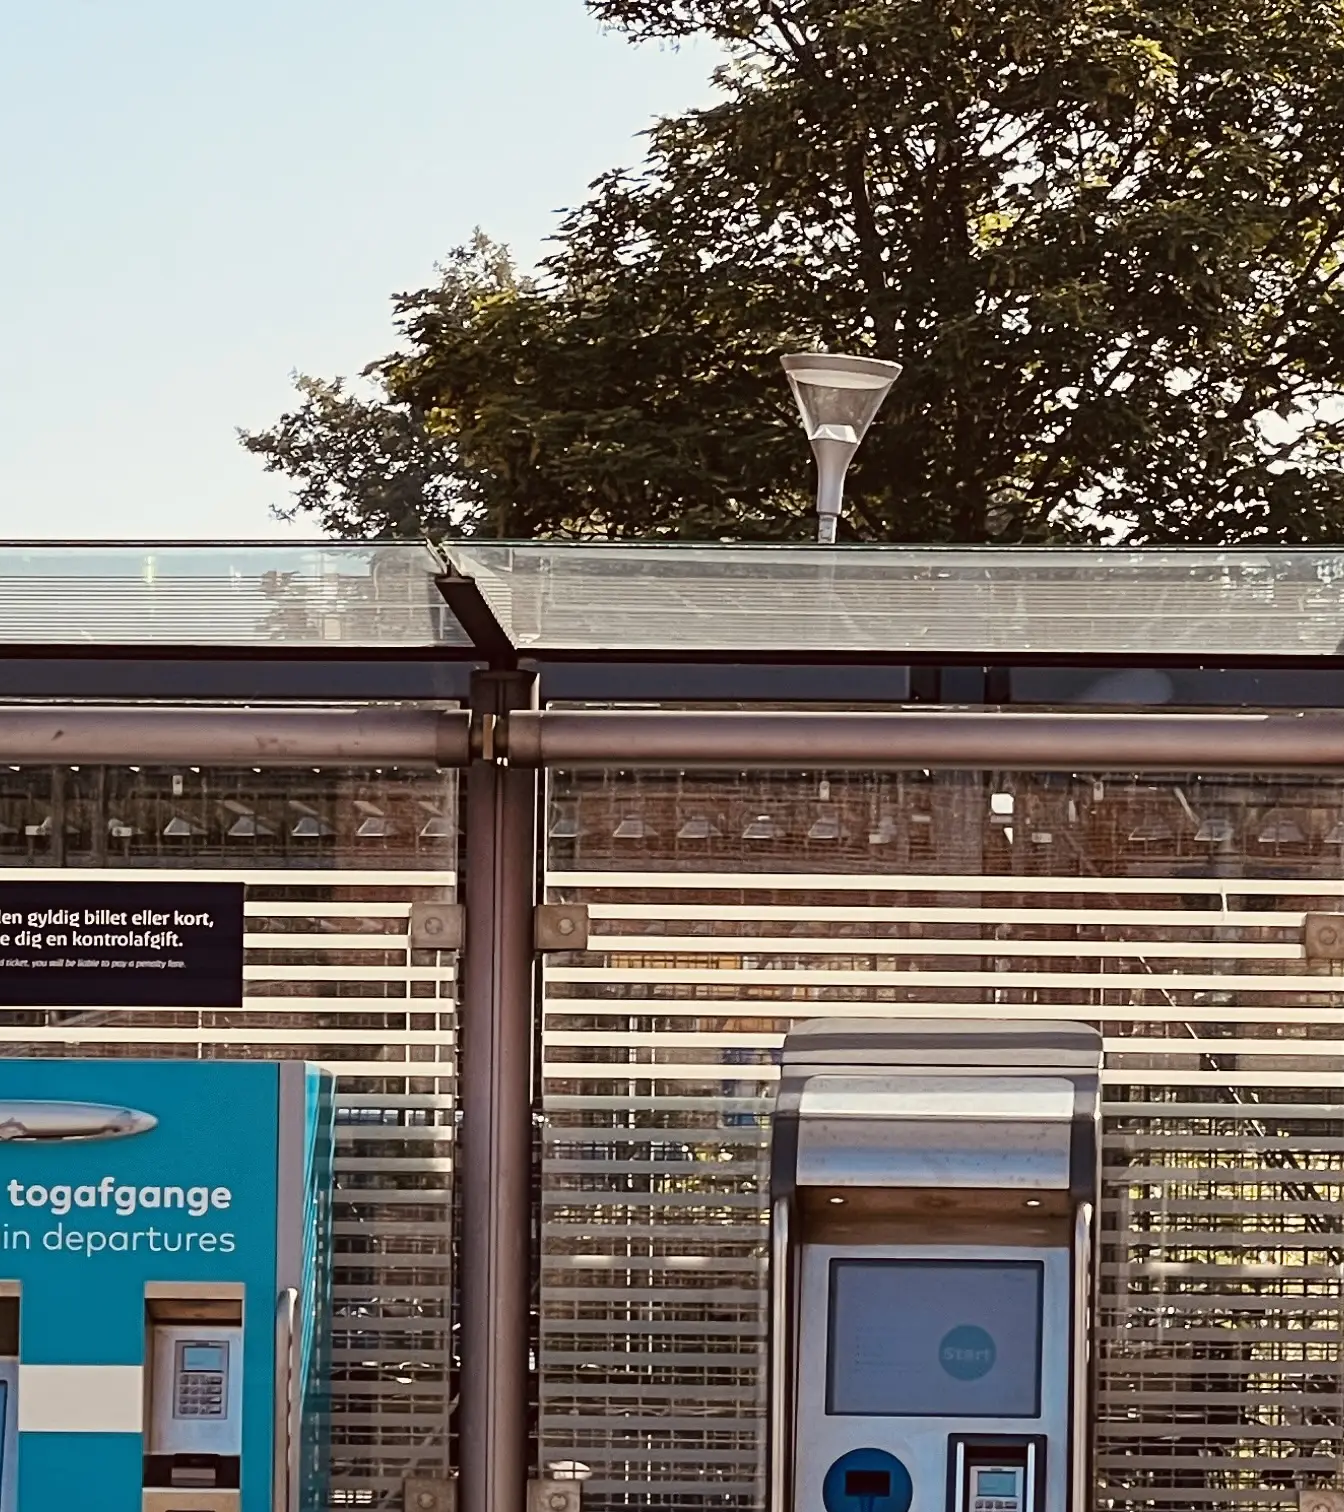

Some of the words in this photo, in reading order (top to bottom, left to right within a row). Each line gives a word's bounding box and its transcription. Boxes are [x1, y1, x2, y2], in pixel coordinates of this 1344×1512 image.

[27, 909, 80, 928] gyldig
[84, 909, 128, 925] billet
[131, 910, 170, 926] eller
[174, 910, 214, 928] kort,
[14, 931, 42, 949] dig
[46, 934, 68, 946] en
[72, 931, 184, 950] kontrolafgift.
[7, 1176, 232, 1217] togafgange
[43, 1222, 236, 1257] departures
